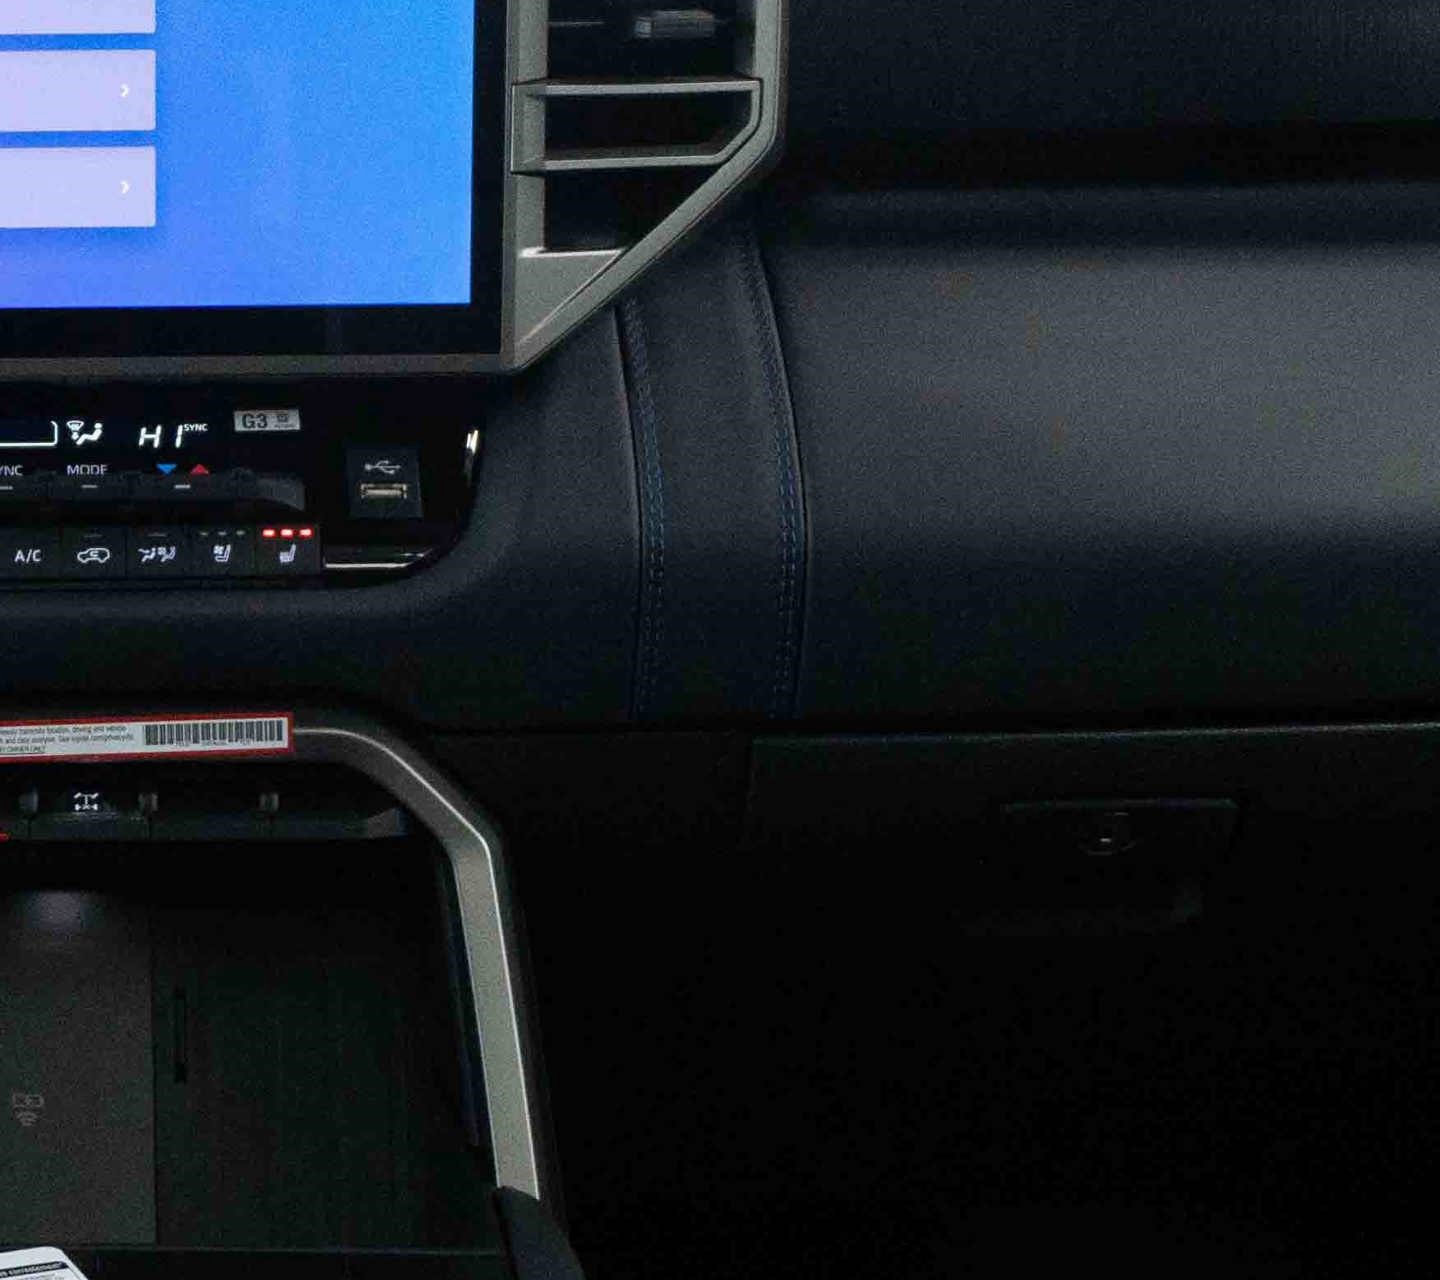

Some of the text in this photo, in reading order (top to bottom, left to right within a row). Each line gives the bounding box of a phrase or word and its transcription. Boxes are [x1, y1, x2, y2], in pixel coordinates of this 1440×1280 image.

[242, 413, 267, 428] G3
[183, 423, 208, 432] SYNC
[14, 549, 41, 562] A/C
